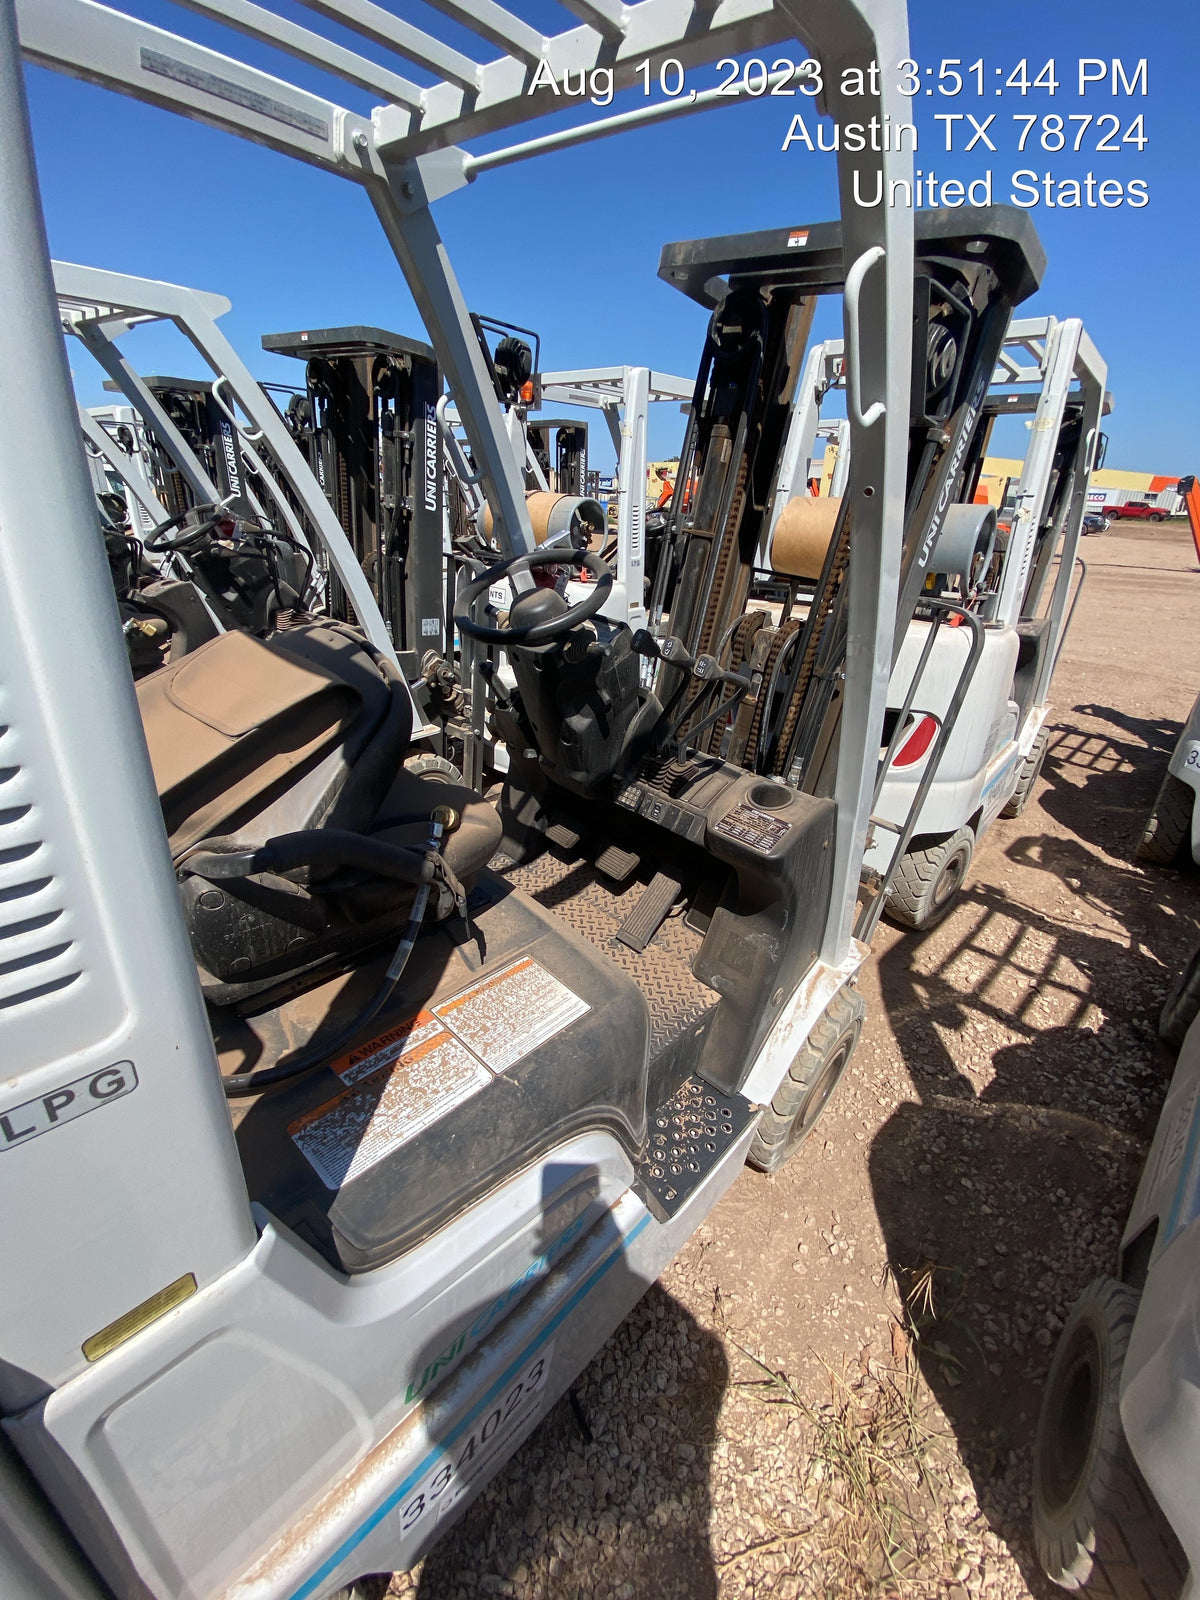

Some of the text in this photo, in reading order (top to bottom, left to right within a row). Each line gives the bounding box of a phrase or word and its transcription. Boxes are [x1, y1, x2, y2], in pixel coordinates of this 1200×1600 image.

[221, 420, 241, 498] UNICARRIERS
[425, 403, 437, 512] UNICARRIERS
[916, 379, 986, 568] UNICARRIERS
[360, 1018, 421, 1057] WARNING
[0, 1069, 125, 1142] LPG
[402, 1358, 545, 1531] 334023
